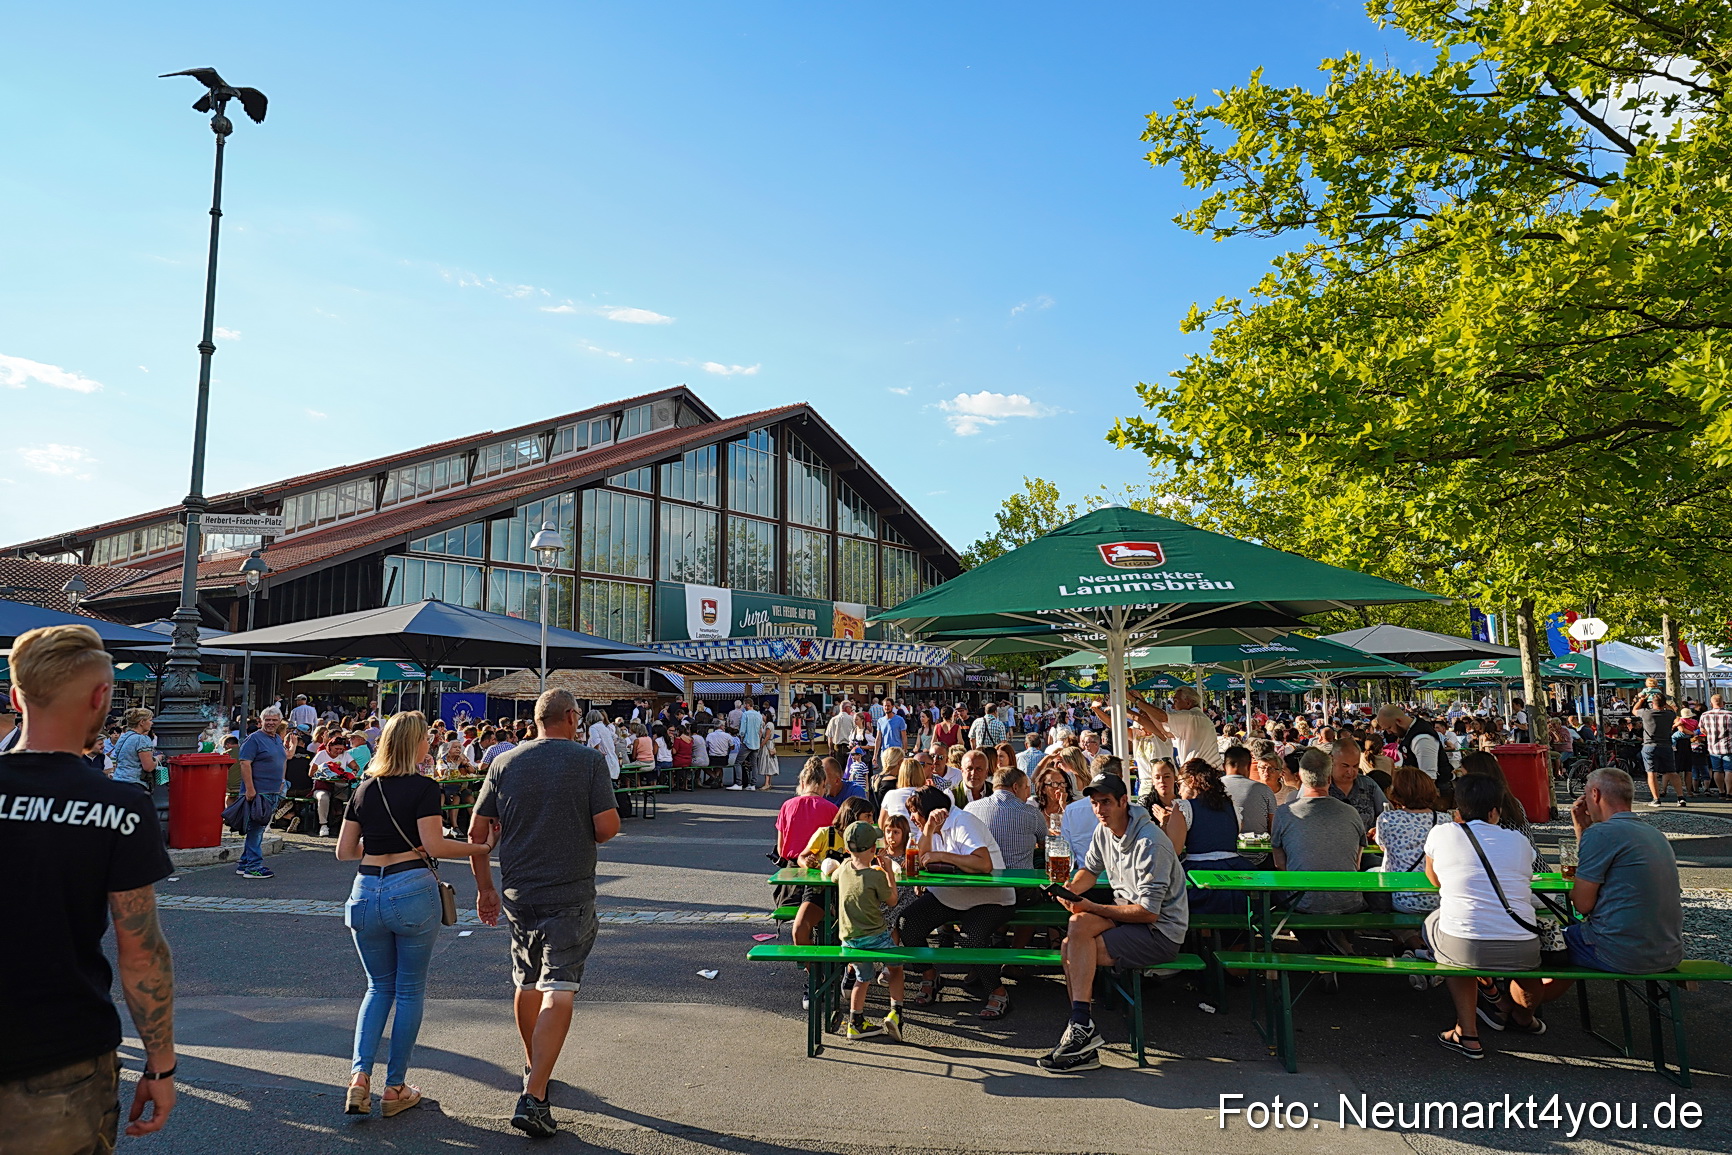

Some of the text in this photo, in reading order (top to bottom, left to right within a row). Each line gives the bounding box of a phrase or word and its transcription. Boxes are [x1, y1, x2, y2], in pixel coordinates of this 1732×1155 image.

[205, 516, 282, 526] Herbert-Fischer-Platz
[1079, 571, 1204, 583] Neumarkter
[1058, 579, 1236, 597] Lammsbräu
[739, 607, 770, 629] Jura
[771, 604, 783, 617] VIEL
[782, 605, 798, 619] FREUDE
[798, 607, 807, 620] AUF
[1582, 622, 1595, 636] WC
[825, 640, 927, 663] Liebermann
[52, 800, 141, 836] JEANS
